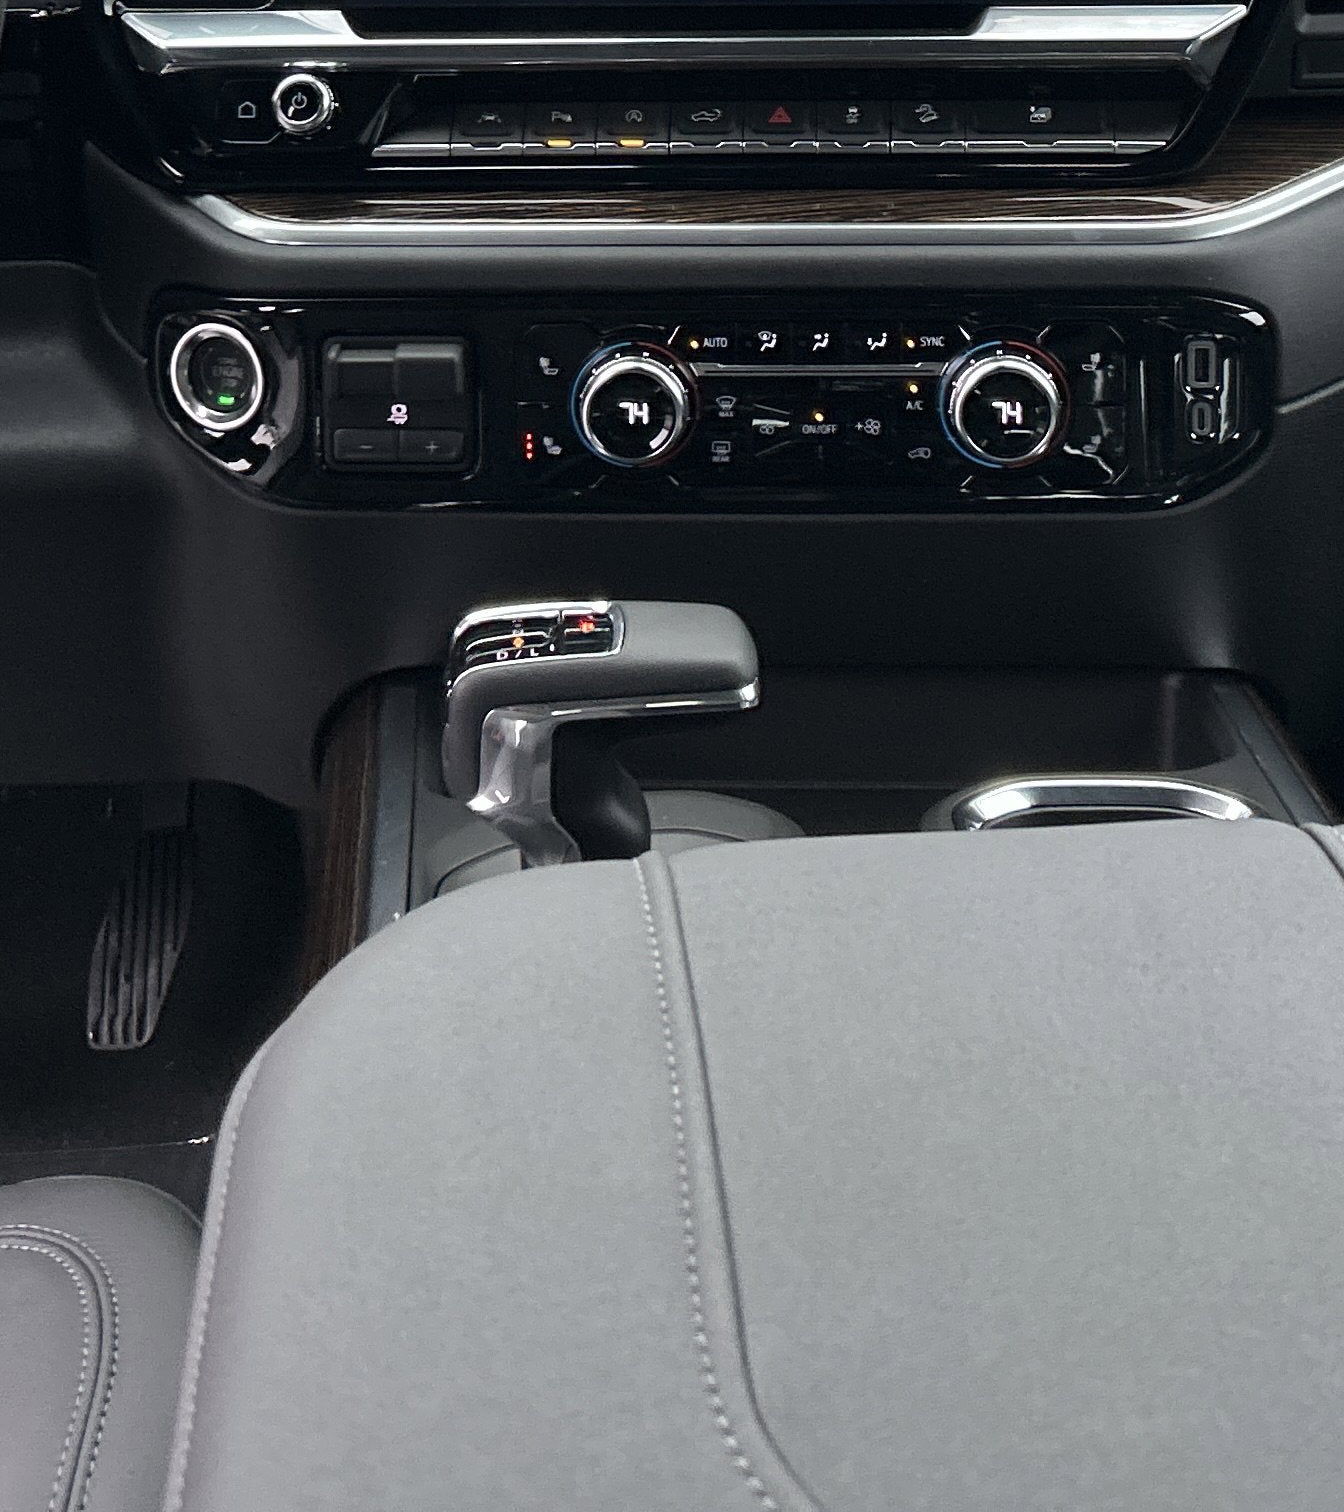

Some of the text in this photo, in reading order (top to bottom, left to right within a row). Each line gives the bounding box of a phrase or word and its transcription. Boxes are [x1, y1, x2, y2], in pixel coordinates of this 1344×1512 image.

[703, 338, 728, 348] AUTO
[919, 337, 945, 347] SYNC
[906, 400, 924, 411] A/C
[618, 401, 650, 425] 74
[991, 401, 1023, 425] 74
[802, 424, 837, 435] ON/OFF
